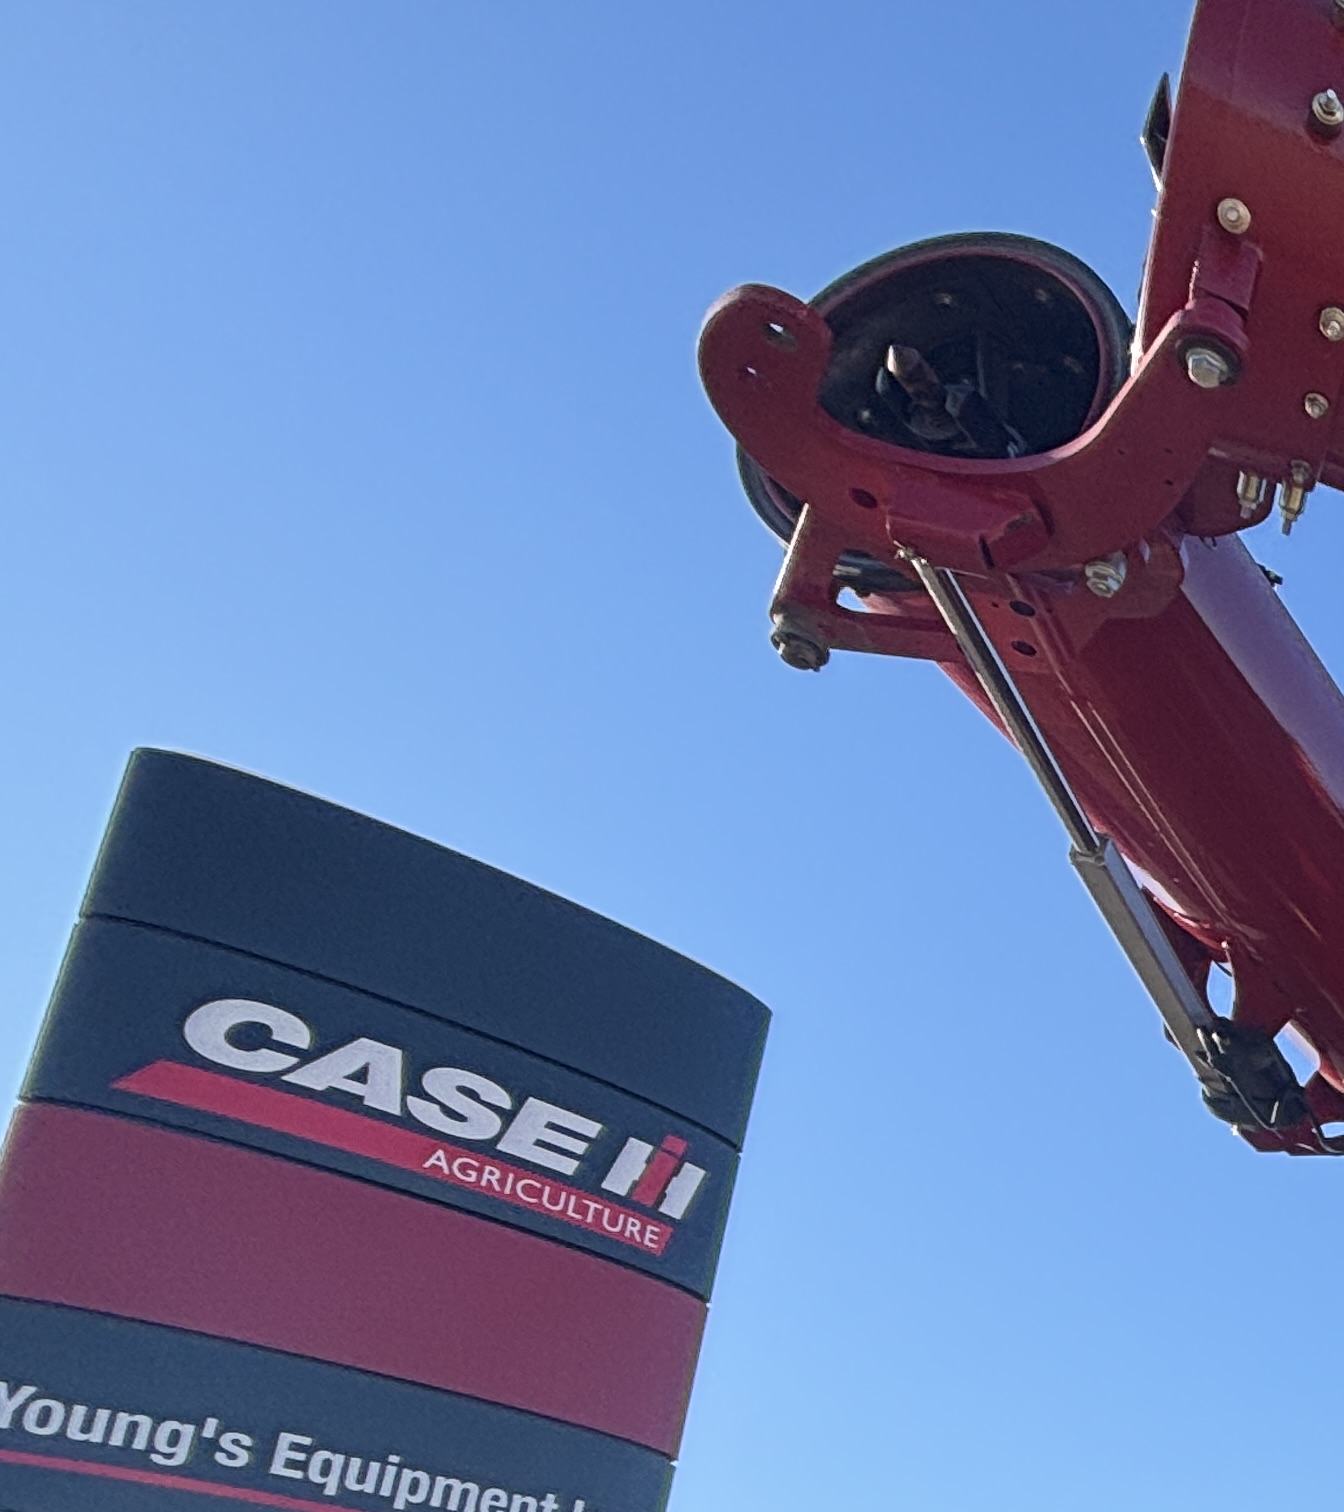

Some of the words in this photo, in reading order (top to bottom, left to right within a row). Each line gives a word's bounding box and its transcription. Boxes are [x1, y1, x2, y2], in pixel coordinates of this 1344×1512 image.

[184, 998, 602, 1176] CASE
[422, 1149, 661, 1249] AGRICULTURE
[0, 1380, 254, 1468] Young's
